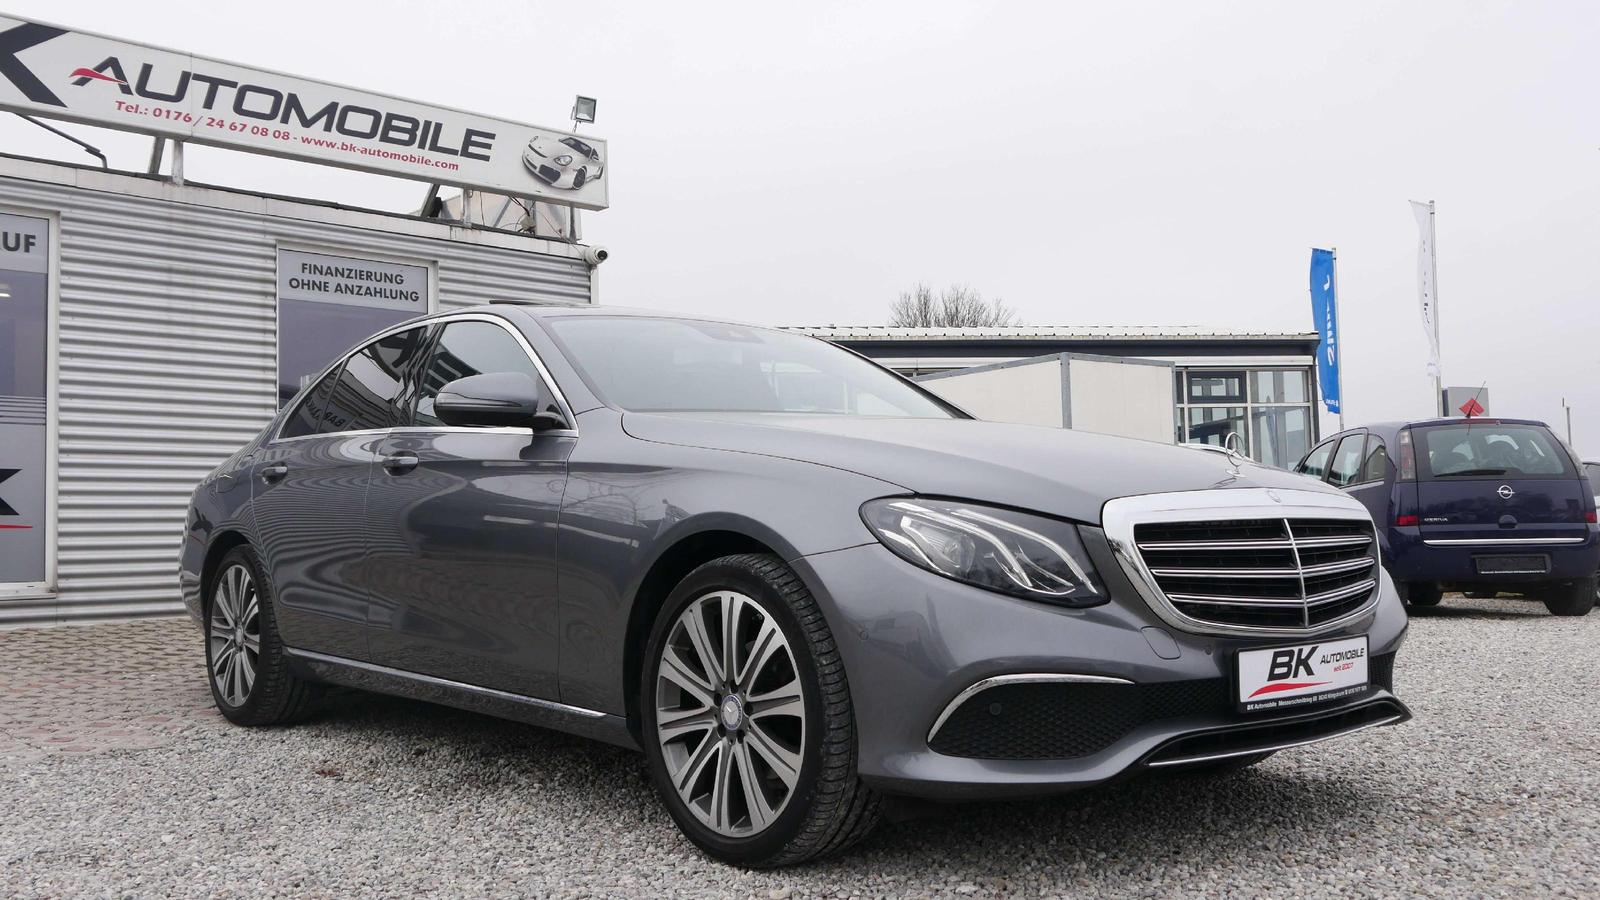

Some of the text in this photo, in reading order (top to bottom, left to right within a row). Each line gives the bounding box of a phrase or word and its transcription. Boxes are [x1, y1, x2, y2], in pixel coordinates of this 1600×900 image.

[70, 56, 496, 162] AUTOMOBILE
[115, 100, 148, 115] Tel.:
[153, 107, 192, 123] 0176
[206, 117, 225, 129] 24
[229, 122, 247, 132] 67
[251, 126, 269, 136] 08
[273, 130, 290, 141] 08
[301, 135, 459, 171] www.bk-automobile.com
[289, 277, 420, 302] OHNE ANZAHLUNG
[301, 263, 404, 285] FINANZIERUNG
[1267, 645, 1364, 682] BK AUTOMOBILE
